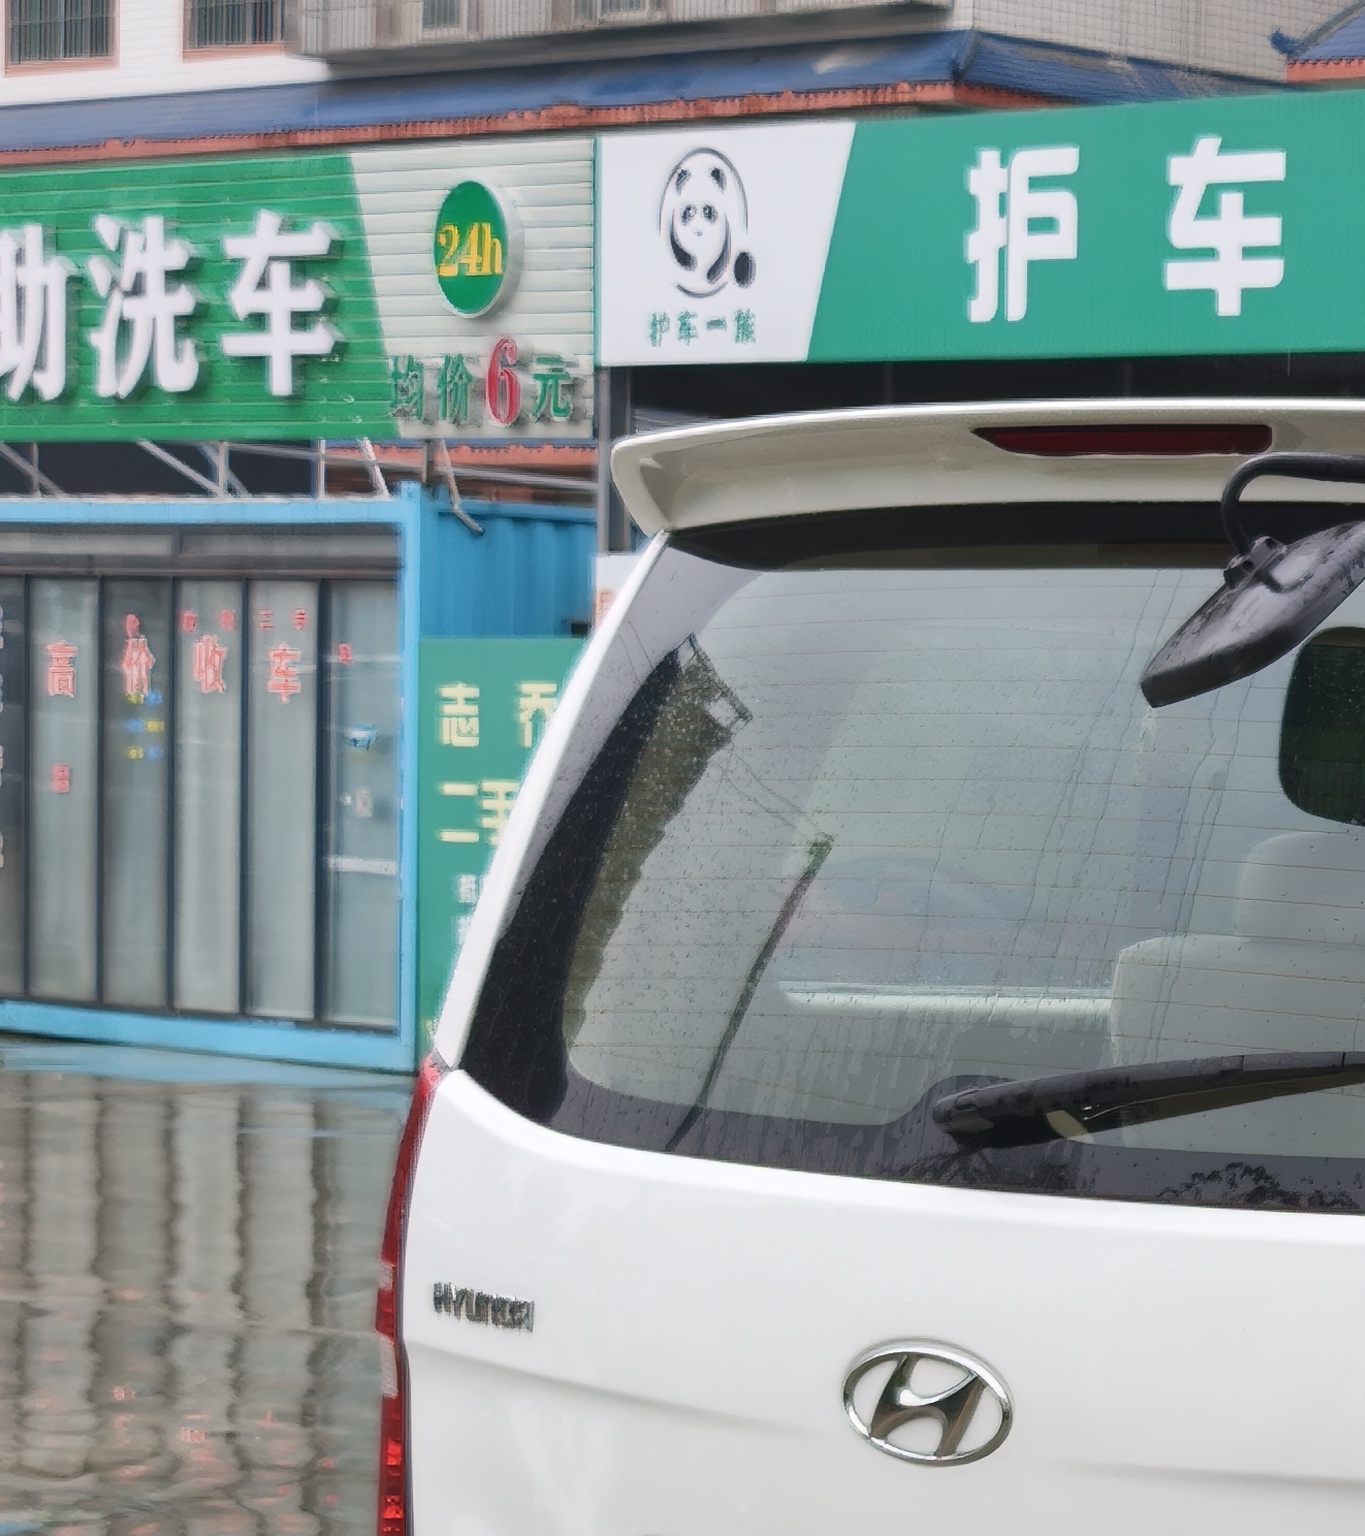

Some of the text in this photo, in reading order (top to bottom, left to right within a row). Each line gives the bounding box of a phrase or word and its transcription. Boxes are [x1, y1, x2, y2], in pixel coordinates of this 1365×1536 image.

[437, 222, 504, 277] 24h
[648, 307, 757, 347] 护车一族
